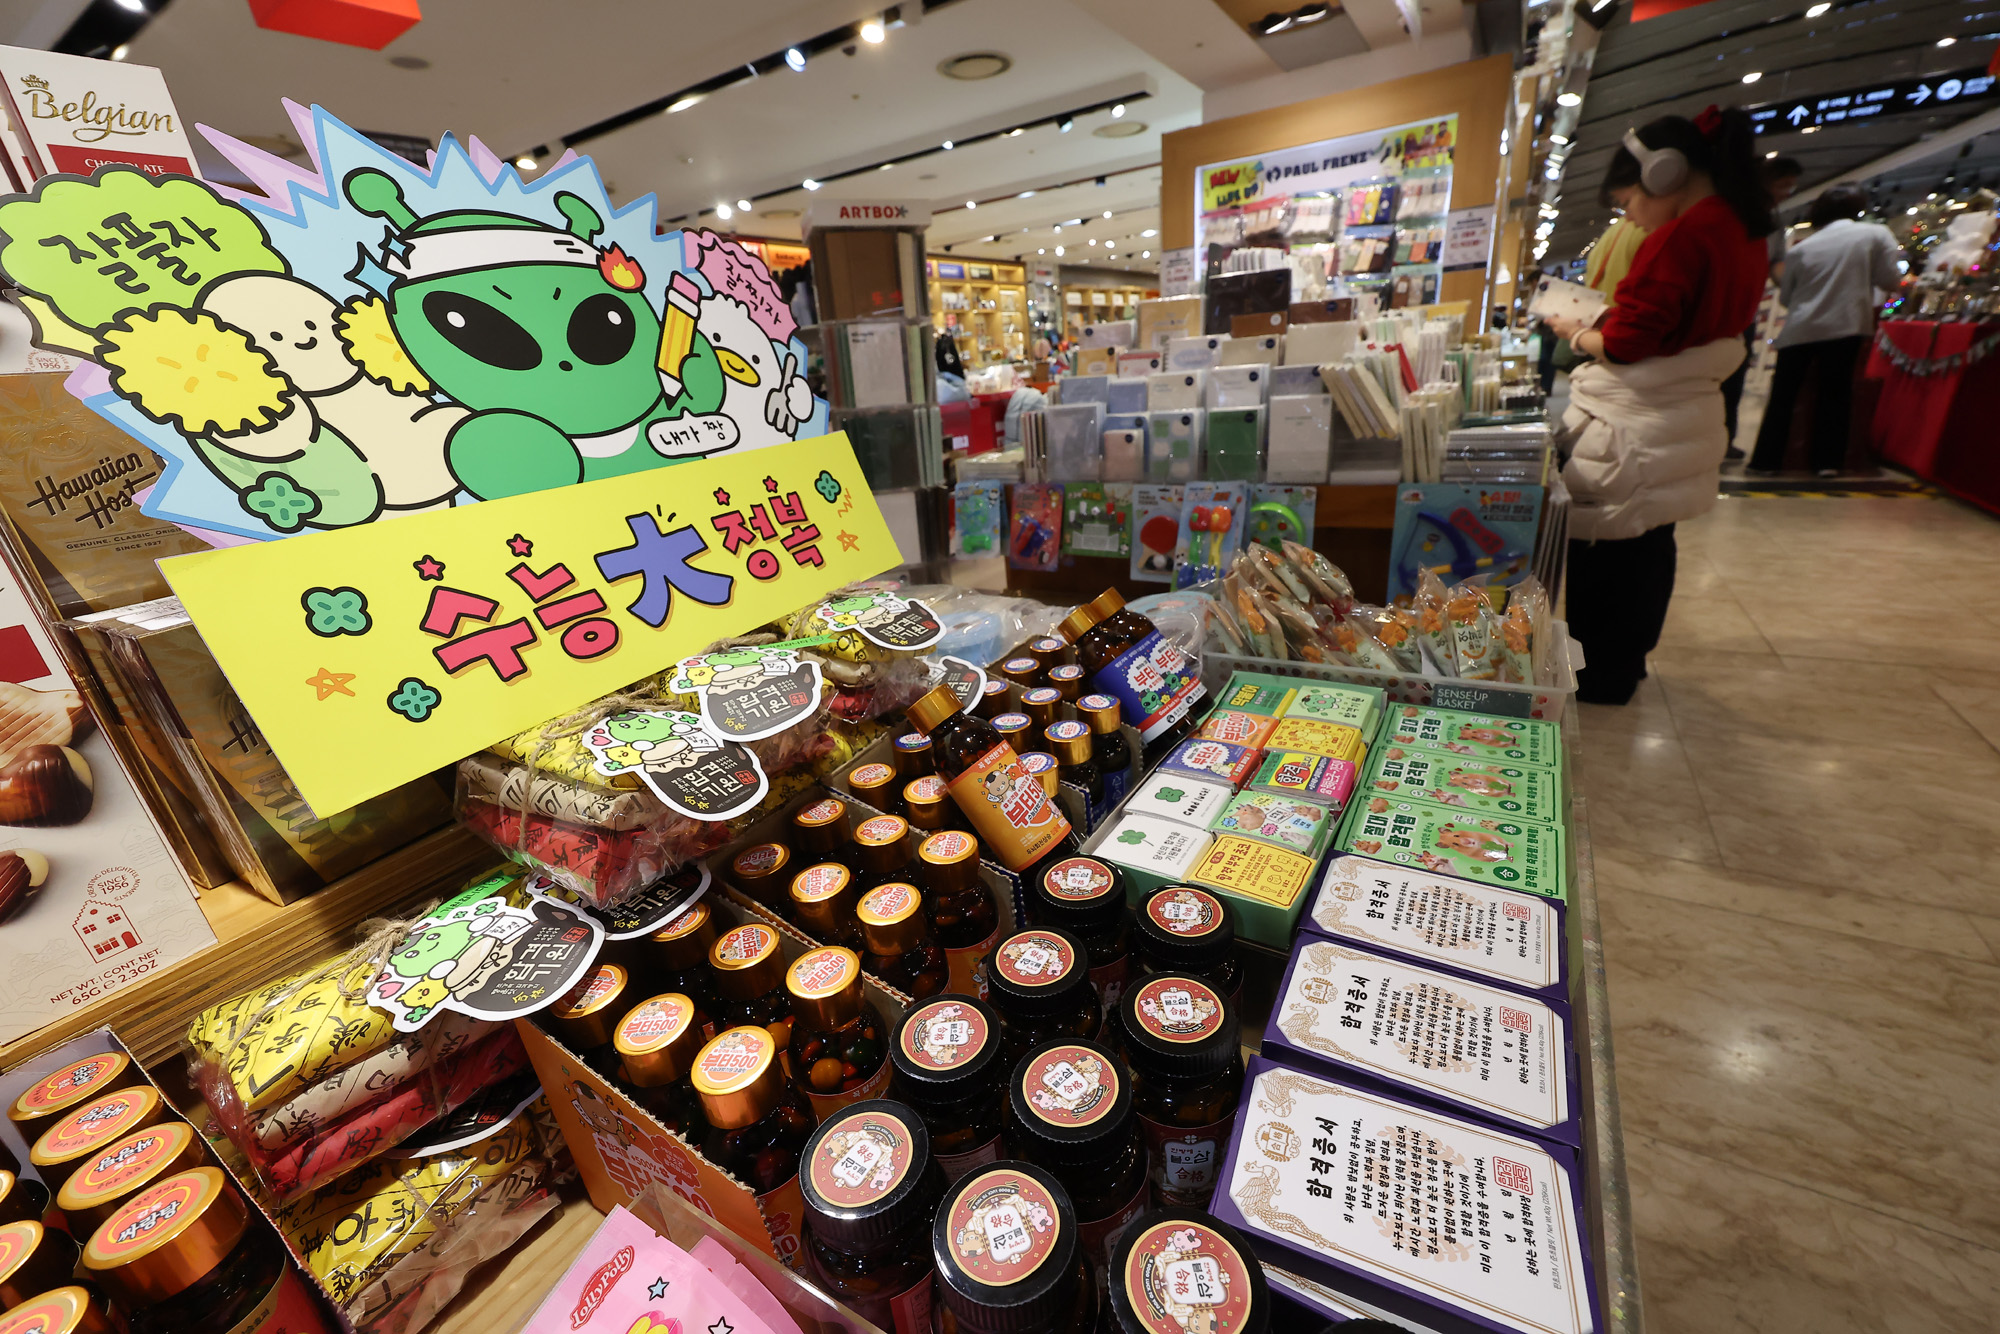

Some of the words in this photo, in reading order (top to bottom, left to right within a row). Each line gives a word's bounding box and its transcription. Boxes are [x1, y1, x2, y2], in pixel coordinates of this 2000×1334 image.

[22, 89, 177, 142] Belgian
[1283, 161, 1319, 178] PAUL
[1322, 151, 1369, 172] FRENZ
[839, 204, 908, 220] ARTBOX
[37, 211, 222, 295] 잘풀자
[725, 260, 782, 326] 잘찍자
[36, 356, 59, 364] SINCE
[38, 362, 62, 370] 1956
[659, 423, 699, 447] 내가
[703, 420, 727, 441] 짱
[27, 452, 144, 516] Hawaiian
[75, 471, 157, 530] Host
[115, 543, 141, 552] SINCE
[143, 539, 163, 548] 1927
[736, 684, 782, 708] 합격
[1436, 698, 1476, 710] BASKET
[1437, 688, 1489, 702] SENSE-UP
[745, 698, 792, 719] 기원
[1222, 713, 1247, 742] 부터500
[1191, 746, 1219, 765] 부터스
[683, 760, 727, 786] 합격
[1276, 763, 1309, 784] 합격
[1382, 760, 1405, 778] 절대
[1403, 760, 1430, 787] 합격햄
[701, 775, 743, 797] 기원
[1182, 800, 1201, 817] Good
[1194, 786, 1212, 802] luck!
[1363, 813, 1389, 838] 절대
[1386, 813, 1417, 849] 합격햄
[1151, 845, 1170, 861] 당신의
[1163, 831, 1181, 845] 합격을
[1164, 835, 1189, 861] 기원합니다!
[1232, 842, 1252, 855] 초코
[1225, 854, 1244, 867] 부적
[87, 870, 102, 899] CREATING
[100, 865, 139, 880] DELIGHTFUL
[97, 874, 127, 891] SINCE
[1215, 866, 1237, 882] 합격
[101, 880, 130, 896] 1956
[1366, 879, 1393, 921] 합격증서
[878, 885, 909, 918] 부터500
[742, 926, 762, 960] 부터500
[502, 943, 548, 981] 합격
[530, 943, 576, 982] 기원
[802, 954, 848, 993] 부터500
[50, 987, 75, 1005] NET
[76, 976, 99, 993] WT.
[104, 957, 138, 979] CONT.
[138, 947, 163, 965] NET.
[71, 986, 102, 1006] 65G
[118, 958, 159, 984] 2.3OZ
[1169, 1007, 1188, 1018] 合格
[1339, 974, 1371, 1031] 합격증서
[621, 1018, 679, 1041] 부터500
[931, 1025, 945, 1045] 合格
[698, 1053, 759, 1075] 부터500
[1051, 1066, 1075, 1089] 붙으삼
[1062, 1079, 1085, 1095] 合格
[1349, 1118, 1362, 1149] 공부하고,
[1364, 1138, 1376, 1154] 집념,
[856, 1143, 875, 1163] 合格
[1170, 1150, 1211, 1165] 붙으삼
[1306, 1116, 1339, 1199] 합격증서
[1379, 1140, 1391, 1162] 열의로
[1410, 1130, 1422, 1168] 다했습니다.
[1426, 1139, 1438, 1155] 받아
[1175, 1166, 1205, 1183] 合格
[1346, 1151, 1359, 1182] 밤낮없이
[1363, 1156, 1374, 1181] 노력과
[1378, 1164, 1390, 1188] 열정과
[1394, 1158, 1406, 1180] 실력을
[1426, 1157, 1438, 1182] 점수를
[1442, 1159, 1454, 1178] 곳에
[1473, 1156, 1488, 1199] 수여합니다.
[1410, 1171, 1422, 1195] 최선을
[1426, 1185, 1438, 1202] 높은
[1442, 1180, 1455, 1206] 원하는
[1458, 1173, 1472, 1208] 것이기에
[1500, 1188, 1512, 1197] 일
[1344, 1185, 1357, 1211] 사람은
[1360, 1184, 1373, 1209] 남다른
[1377, 1191, 1389, 1219] 뜨거운
[1393, 1183, 1405, 1209] 뛰어난
[1426, 1203, 1438, 1213] 더
[115, 1199, 181, 1244] 싸랑탕
[990, 1212, 1015, 1228] 合格
[1343, 1213, 1354, 1223] 위
[1409, 1197, 1422, 1225] 노력과
[1476, 1201, 1490, 1237] 합격증을
[1502, 1210, 1514, 1220] 월
[1519, 1194, 1534, 1226] 합격하장
[1392, 1211, 1404, 1251] 누구보다
[1426, 1216, 1439, 1254] 평소보다
[1443, 1207, 1457, 1244] 틀림없이
[1460, 1210, 1473, 1237] 합격할
[1545, 1222, 1553, 1234] Net
[993, 1228, 1024, 1250] 붙으삼
[1409, 1227, 1422, 1257] 매시간
[1478, 1239, 1491, 1250] 이
[1504, 1233, 1516, 1243] 년
[1522, 1227, 1536, 1247] 곳에
[1479, 1252, 1492, 1273] 미리
[1525, 1249, 1539, 1276] 원하는
[1173, 1267, 1191, 1296] 合格
[1191, 1262, 1214, 1299] 붙으삼
